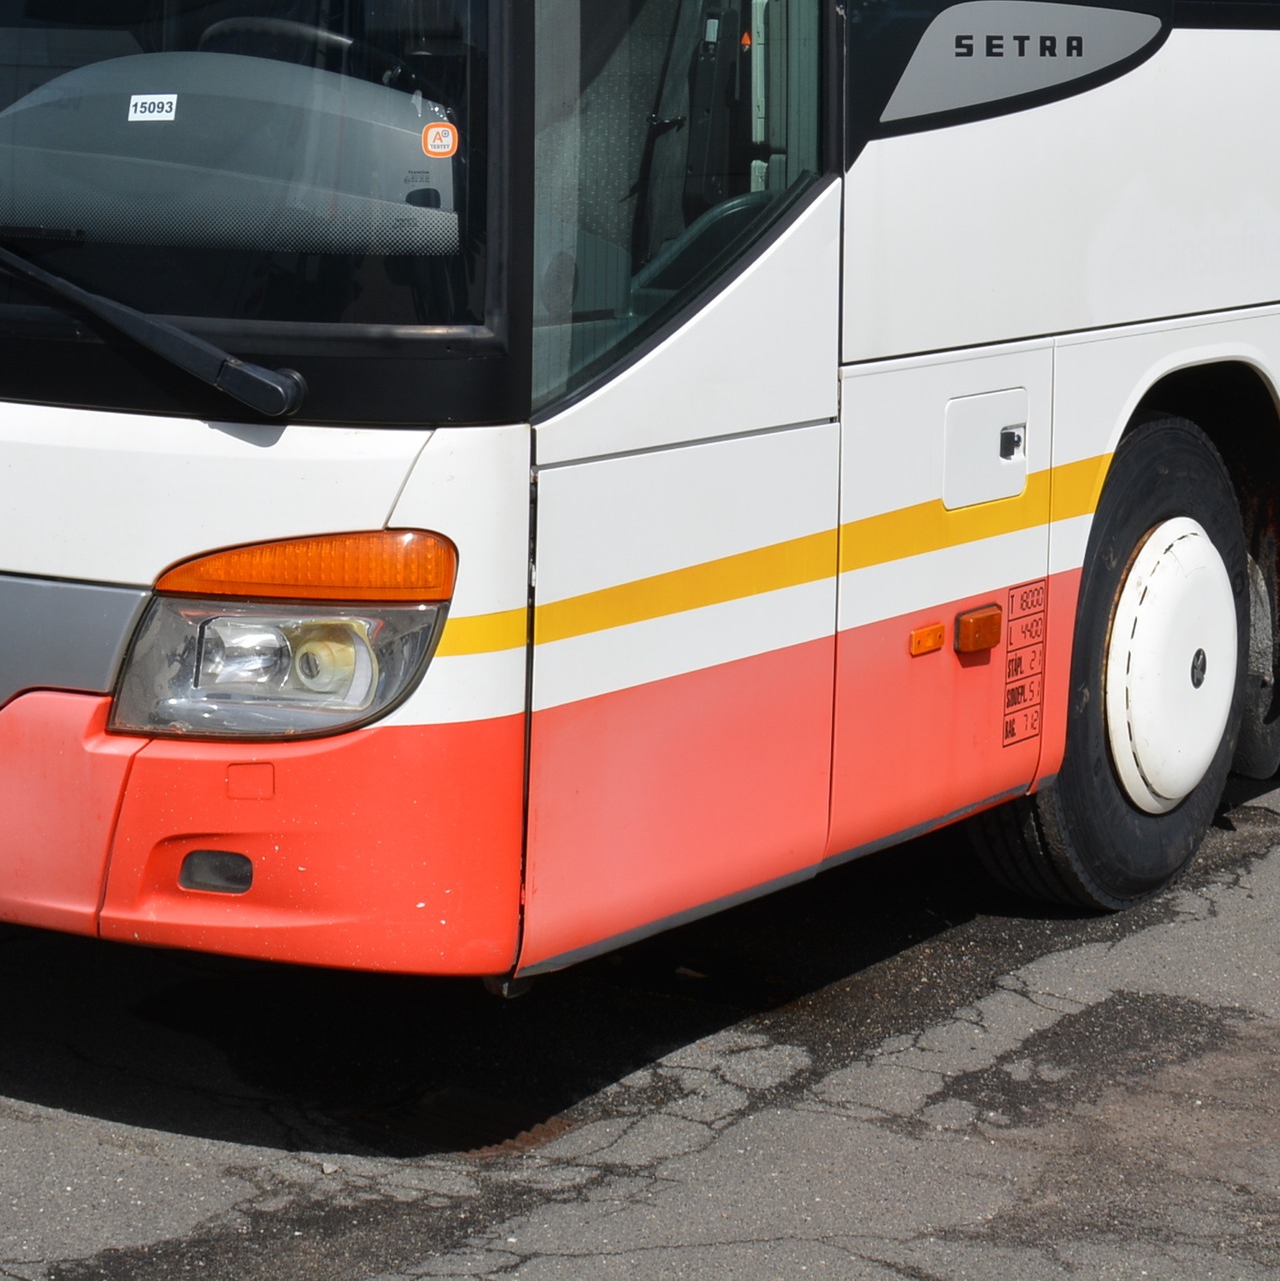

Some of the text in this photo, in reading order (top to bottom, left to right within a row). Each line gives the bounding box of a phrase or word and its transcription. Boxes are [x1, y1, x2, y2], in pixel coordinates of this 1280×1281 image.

[955, 35, 1083, 57] SETRA
[132, 101, 173, 114] 15093
[1021, 586, 1043, 611] 18000
[1021, 618, 1042, 639] 4400
[1030, 650, 1041, 670] 21
[1029, 681, 1040, 701] 51
